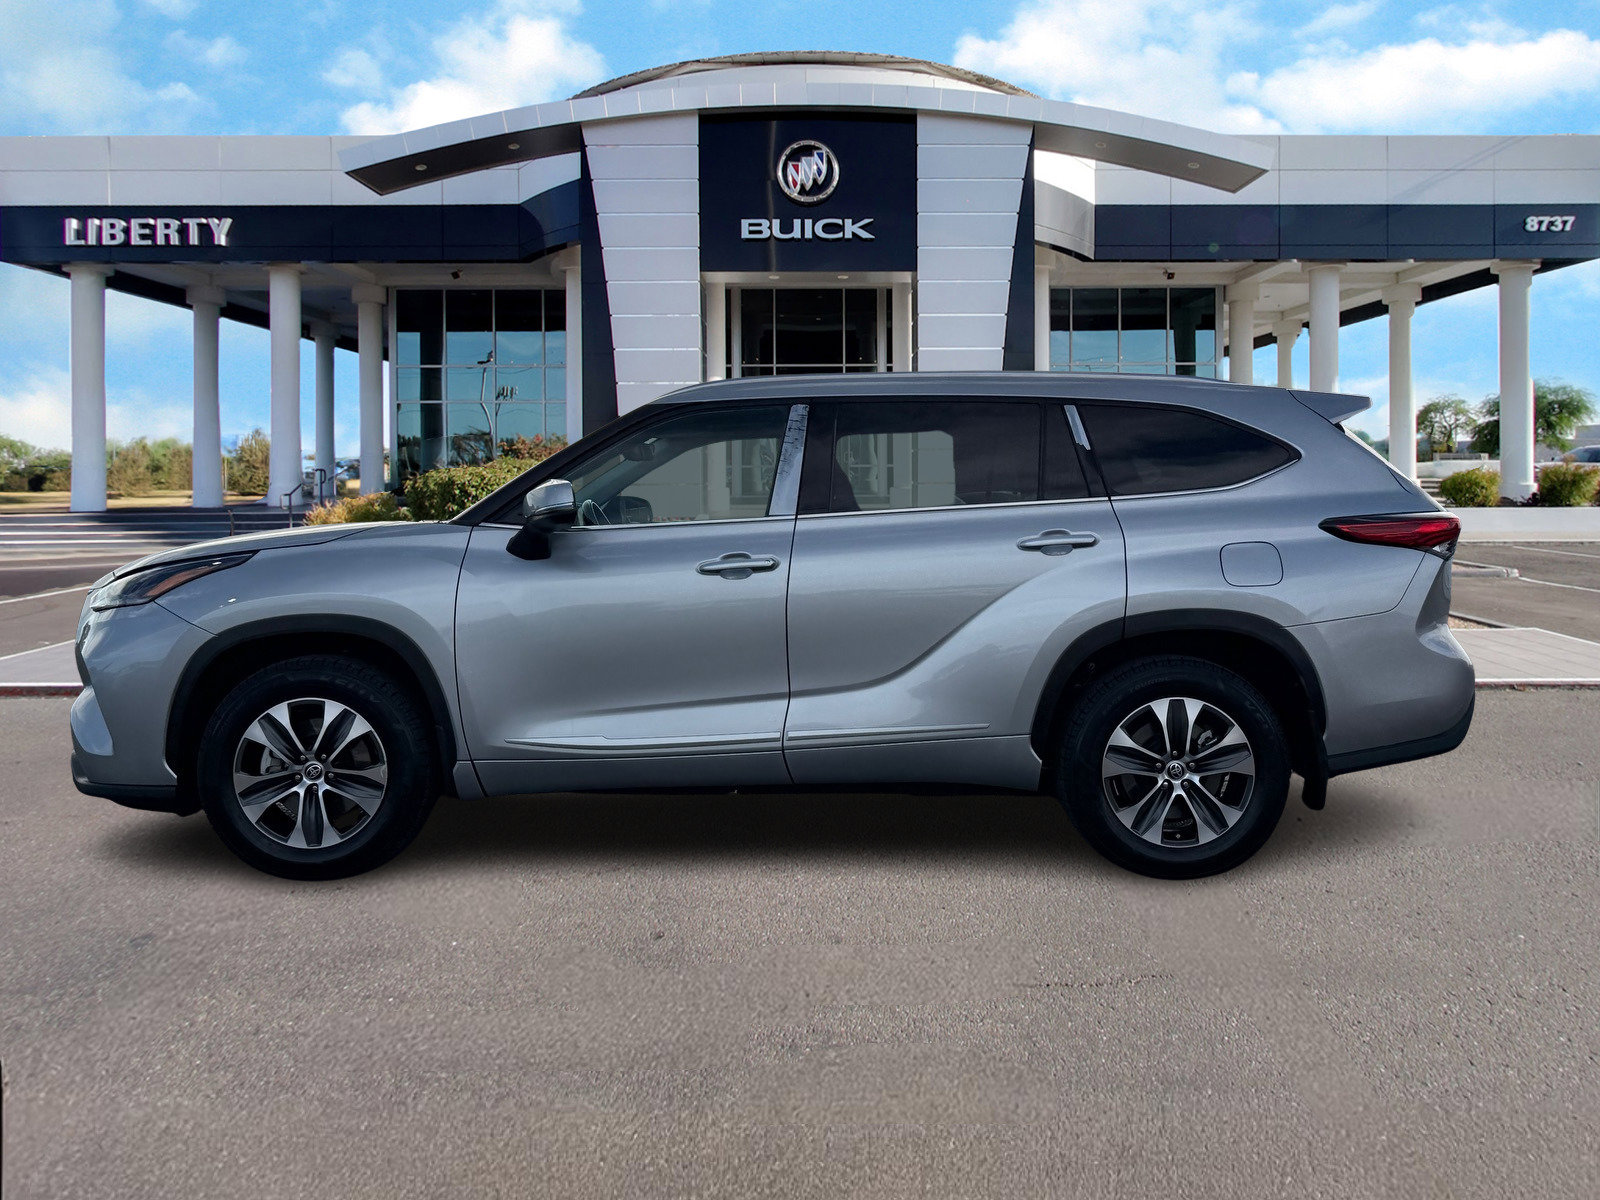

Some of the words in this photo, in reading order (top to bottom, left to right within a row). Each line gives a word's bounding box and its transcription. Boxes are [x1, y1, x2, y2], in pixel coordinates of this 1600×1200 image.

[63, 217, 233, 246] LIBERTY
[740, 218, 876, 240] BUICK
[1524, 215, 1576, 232] 8737
